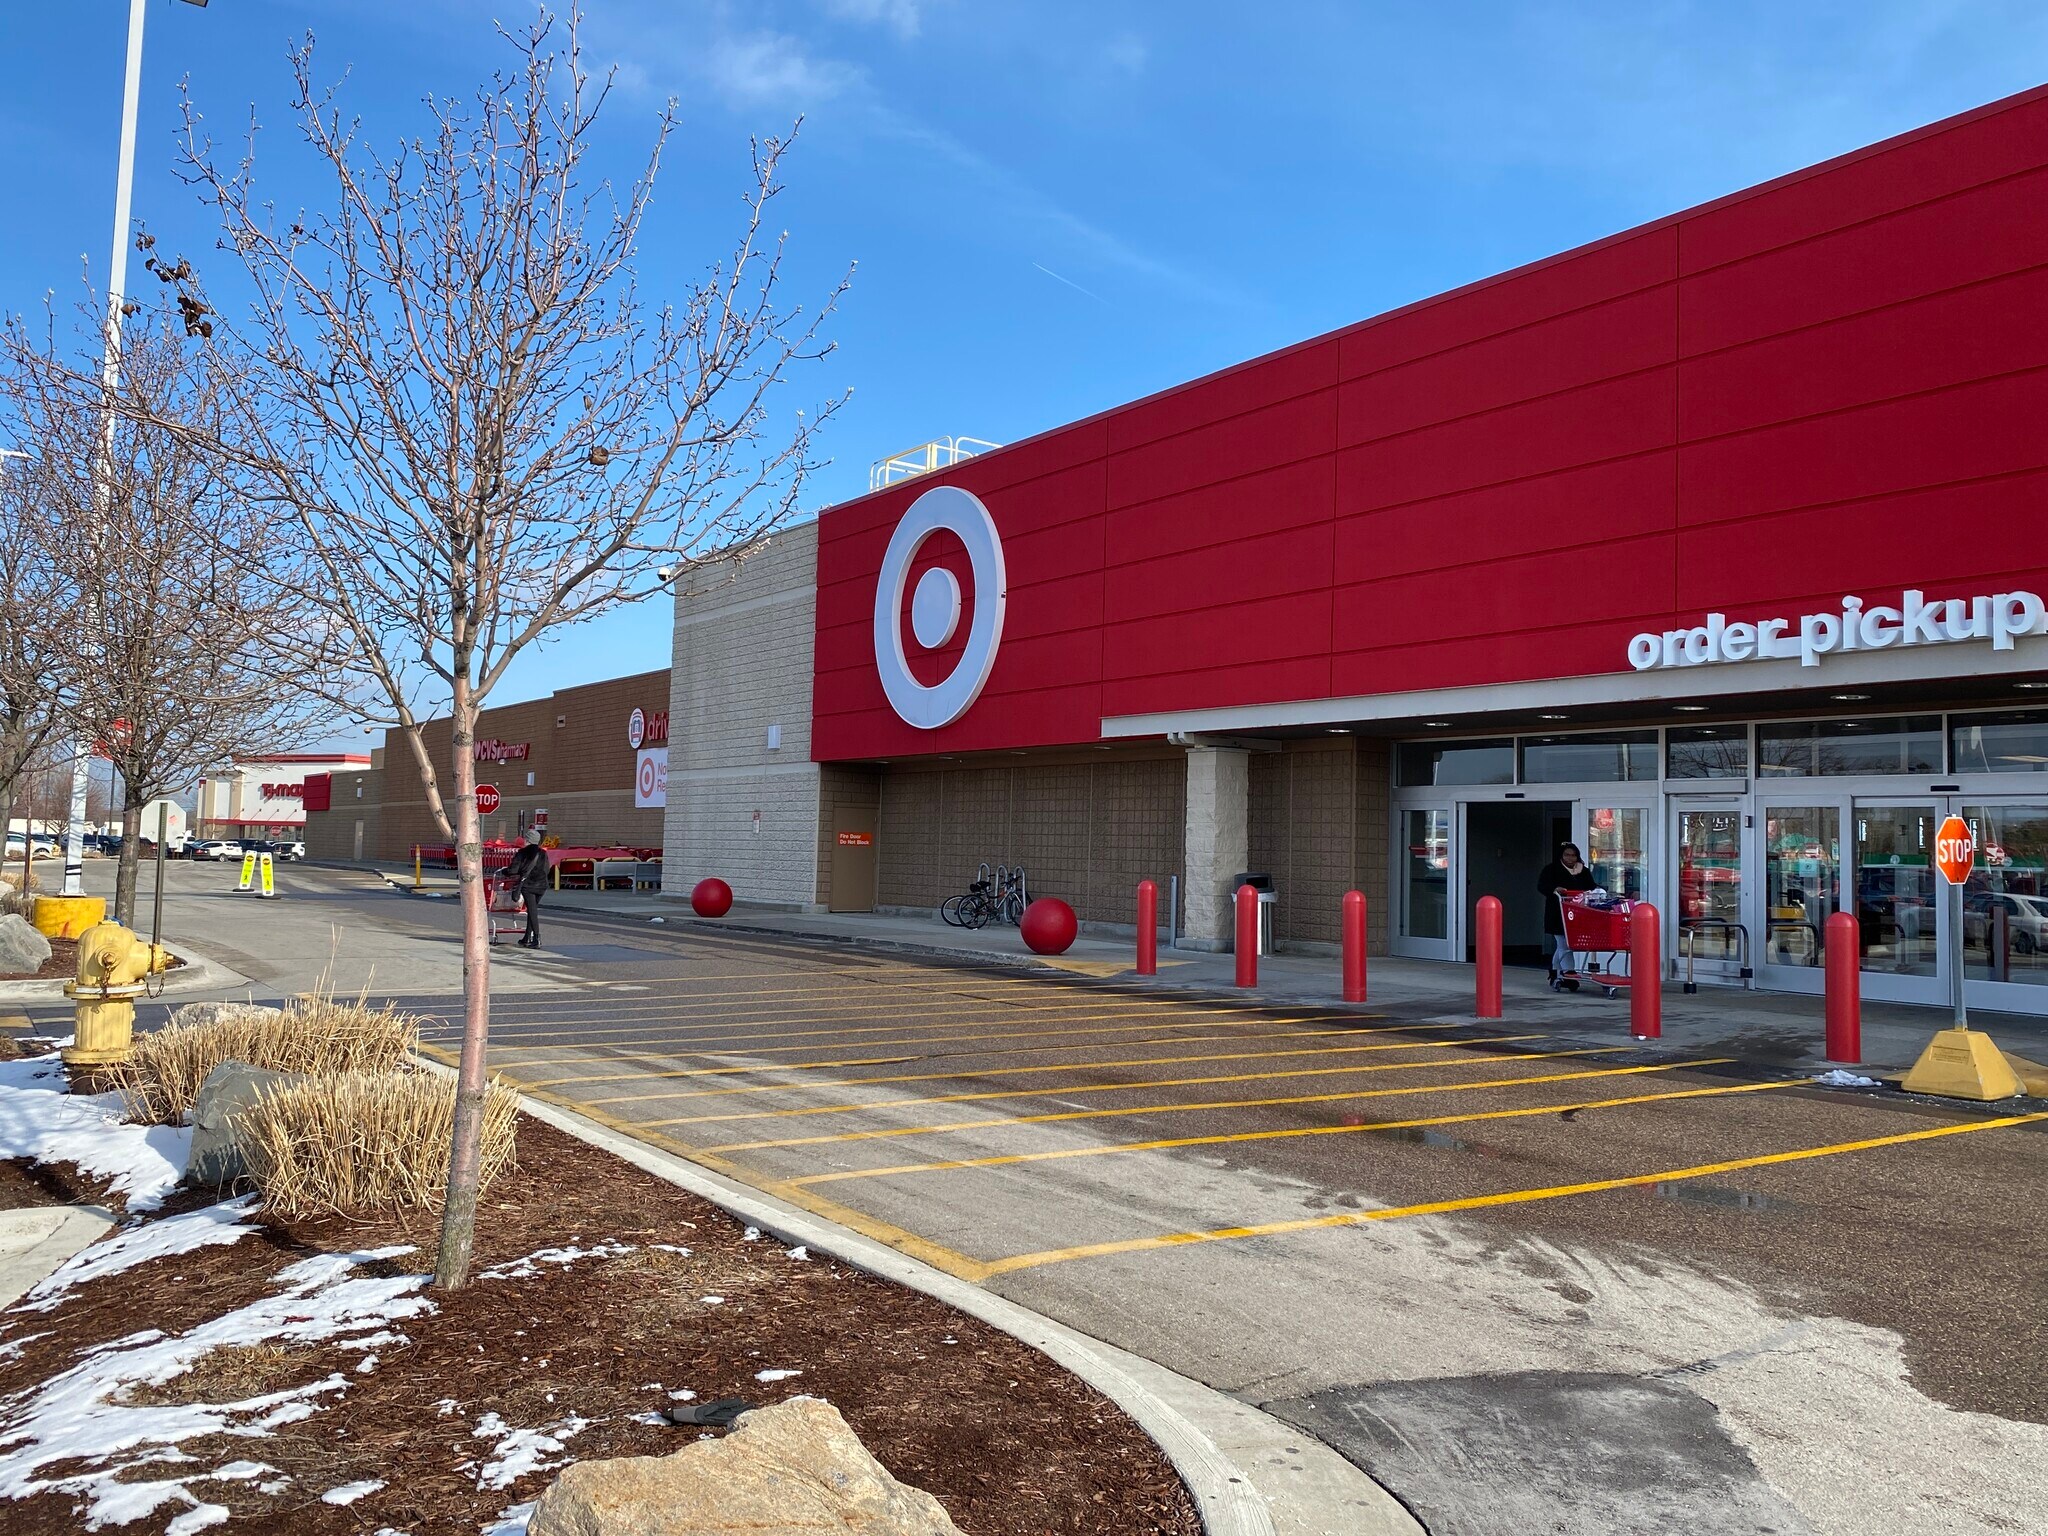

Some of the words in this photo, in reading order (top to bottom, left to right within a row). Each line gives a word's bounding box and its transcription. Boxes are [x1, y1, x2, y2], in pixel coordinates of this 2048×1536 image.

[1627, 612, 1790, 671] order
[1800, 588, 2046, 668] pickup
[480, 739, 498, 760] CVS
[1939, 838, 1972, 863] STOP
